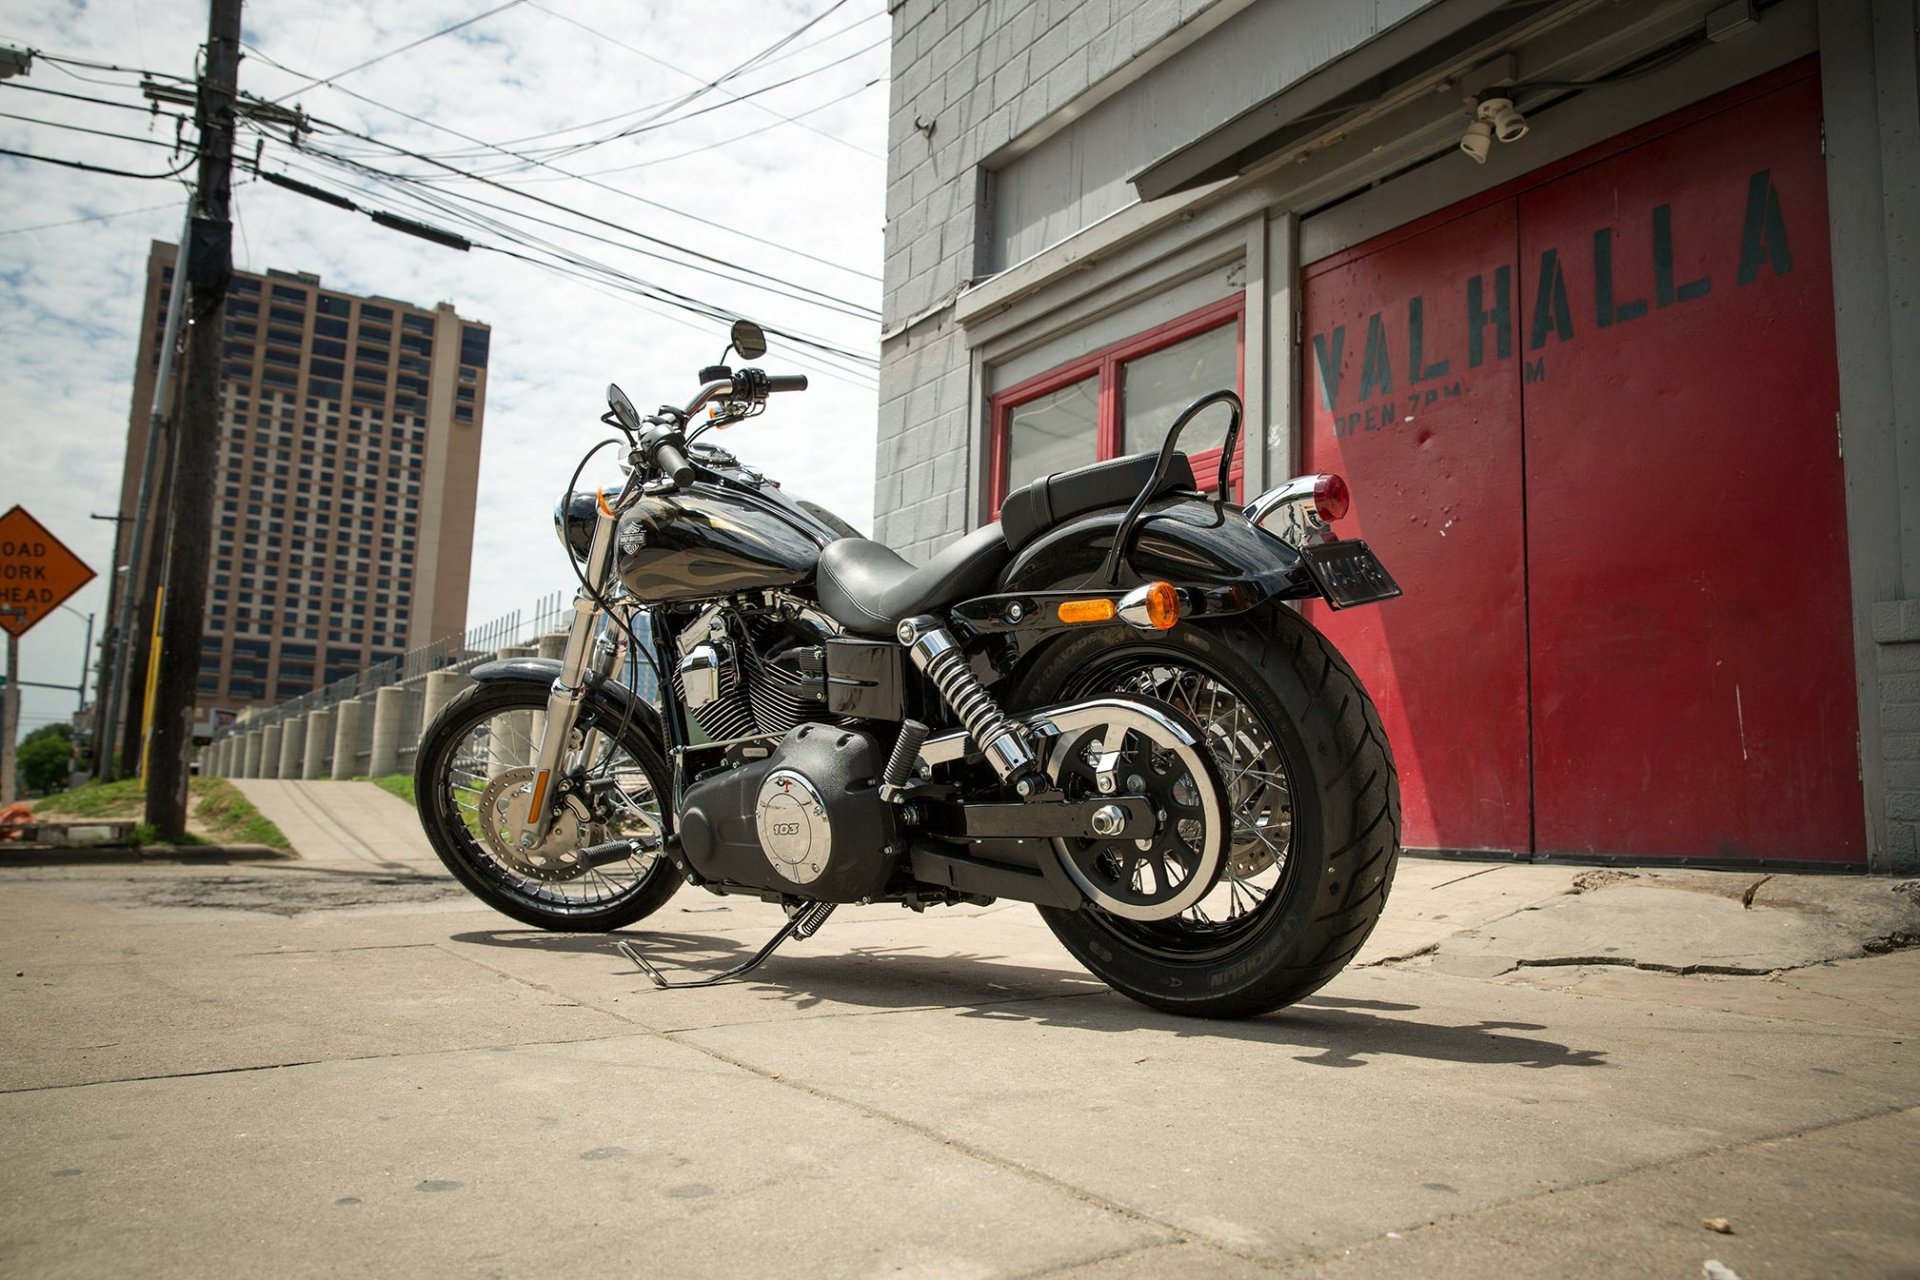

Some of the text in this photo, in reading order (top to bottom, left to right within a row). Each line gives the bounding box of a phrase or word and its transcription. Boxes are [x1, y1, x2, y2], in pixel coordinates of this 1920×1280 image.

[1312, 168, 1794, 413] VALHALLA
[1333, 402, 1396, 438] OPEN
[0, 541, 46, 558] OAD
[0, 563, 46, 580] ORK
[0, 586, 53, 603] HEAD
[773, 822, 800, 836] 103
